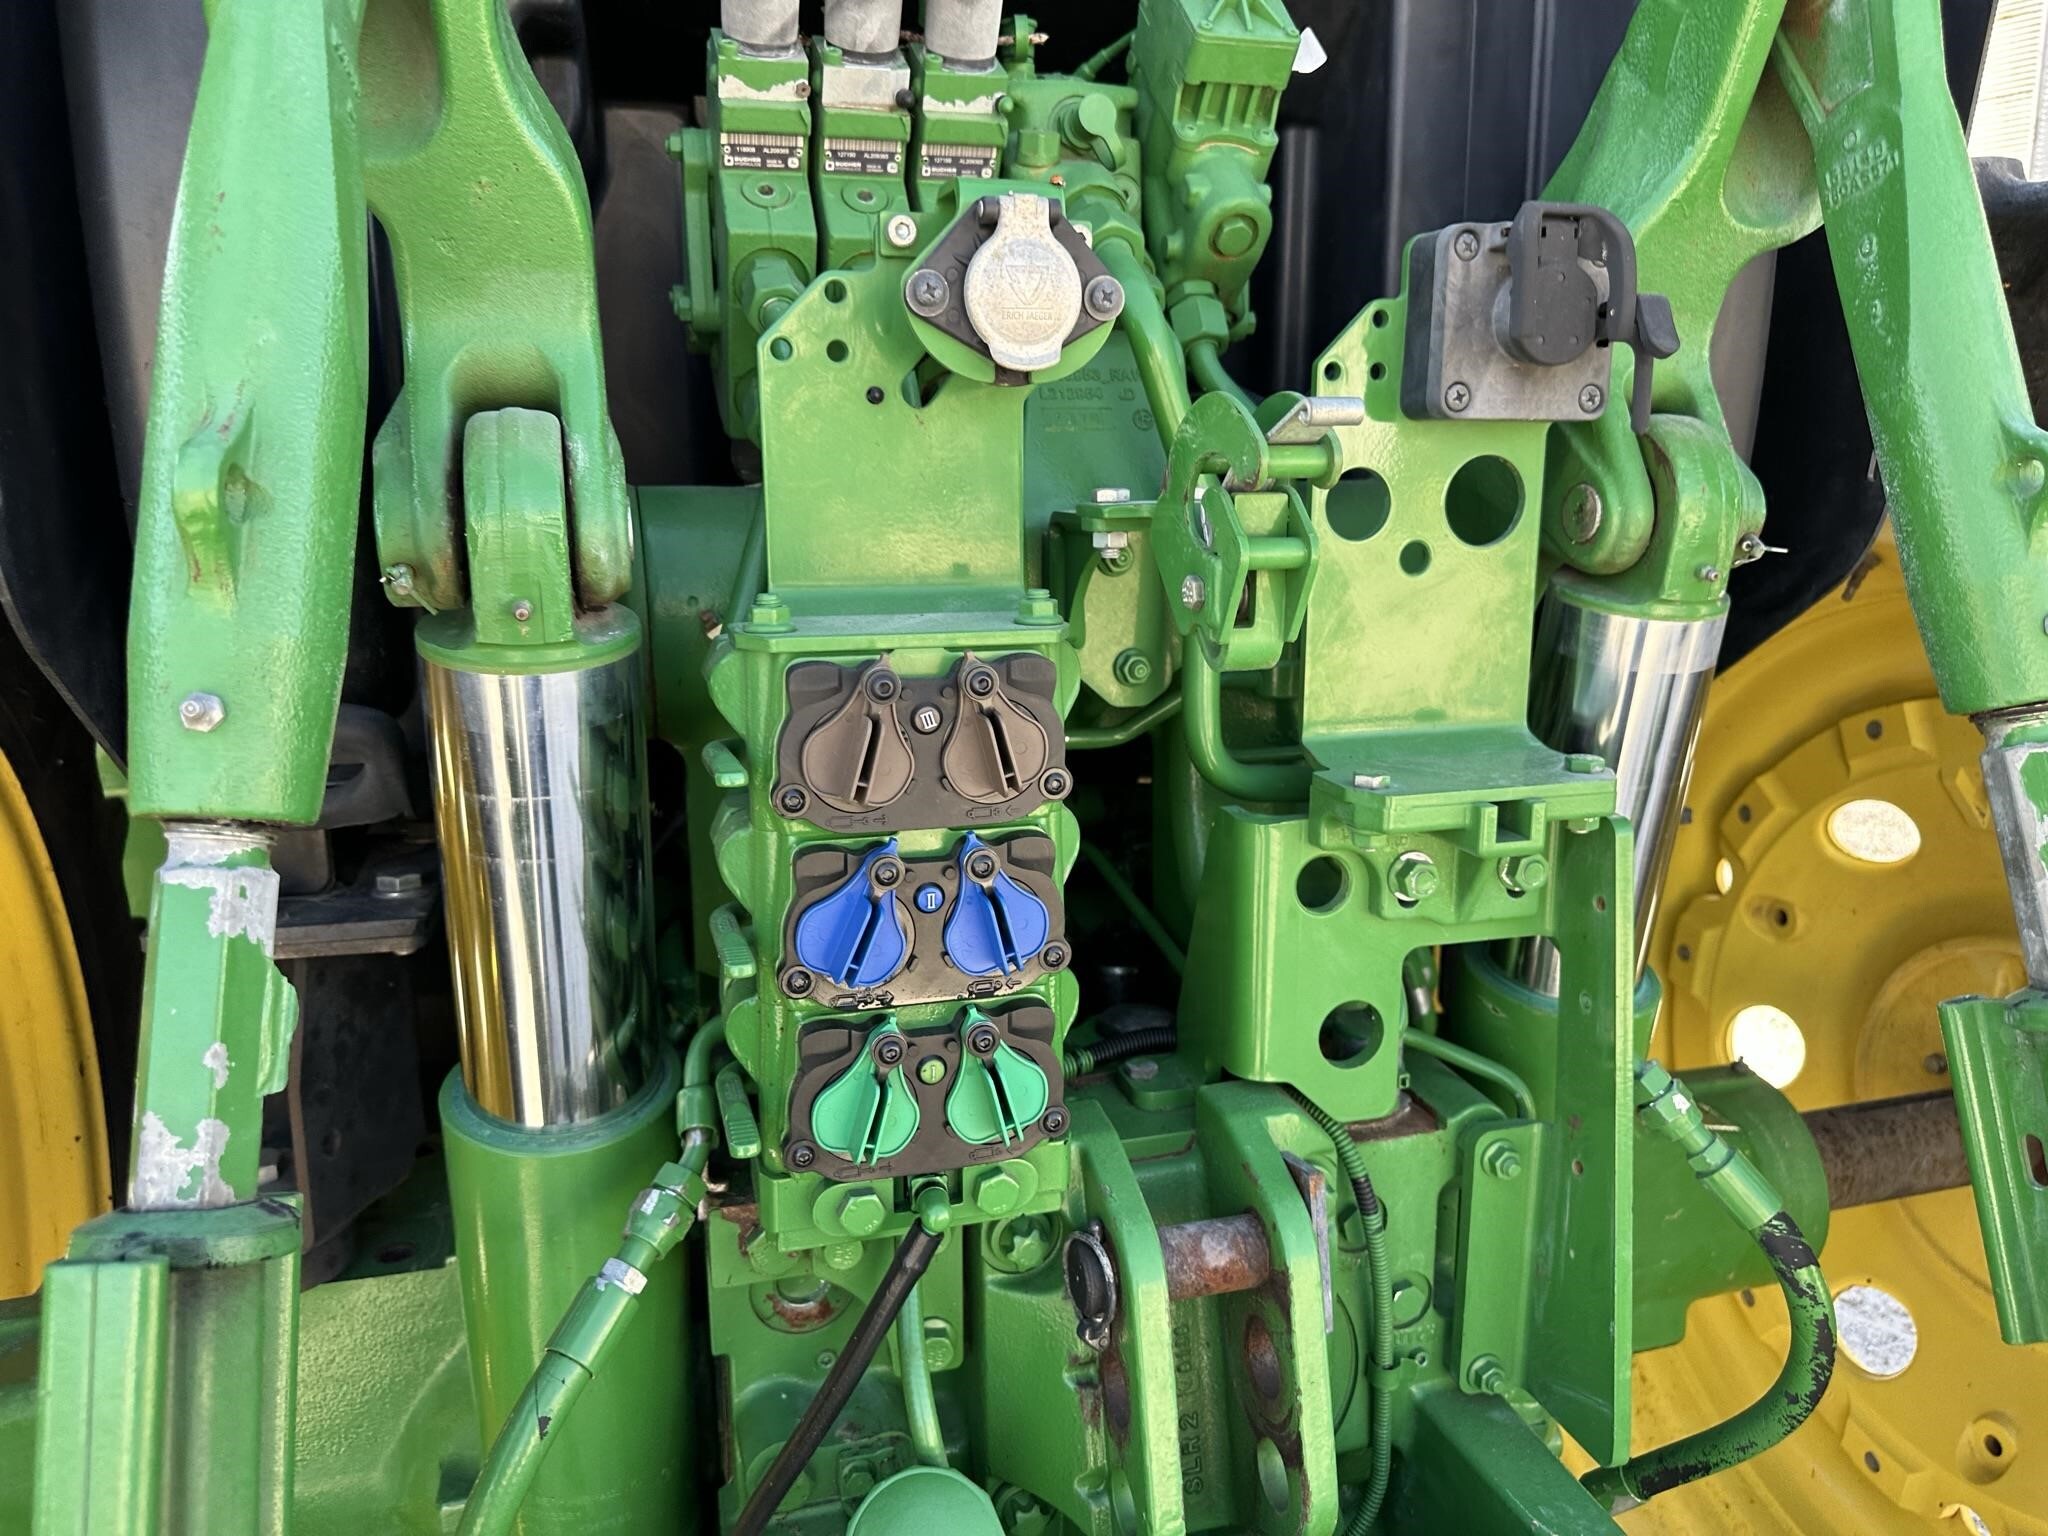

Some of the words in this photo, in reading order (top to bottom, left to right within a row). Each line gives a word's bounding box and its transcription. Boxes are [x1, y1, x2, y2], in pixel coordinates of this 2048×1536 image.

[1002, 310, 1024, 321] ERICH
[1026, 311, 1053, 321] JAEGER
[927, 893, 936, 909] II
[1179, 1411, 1198, 1431] 2
